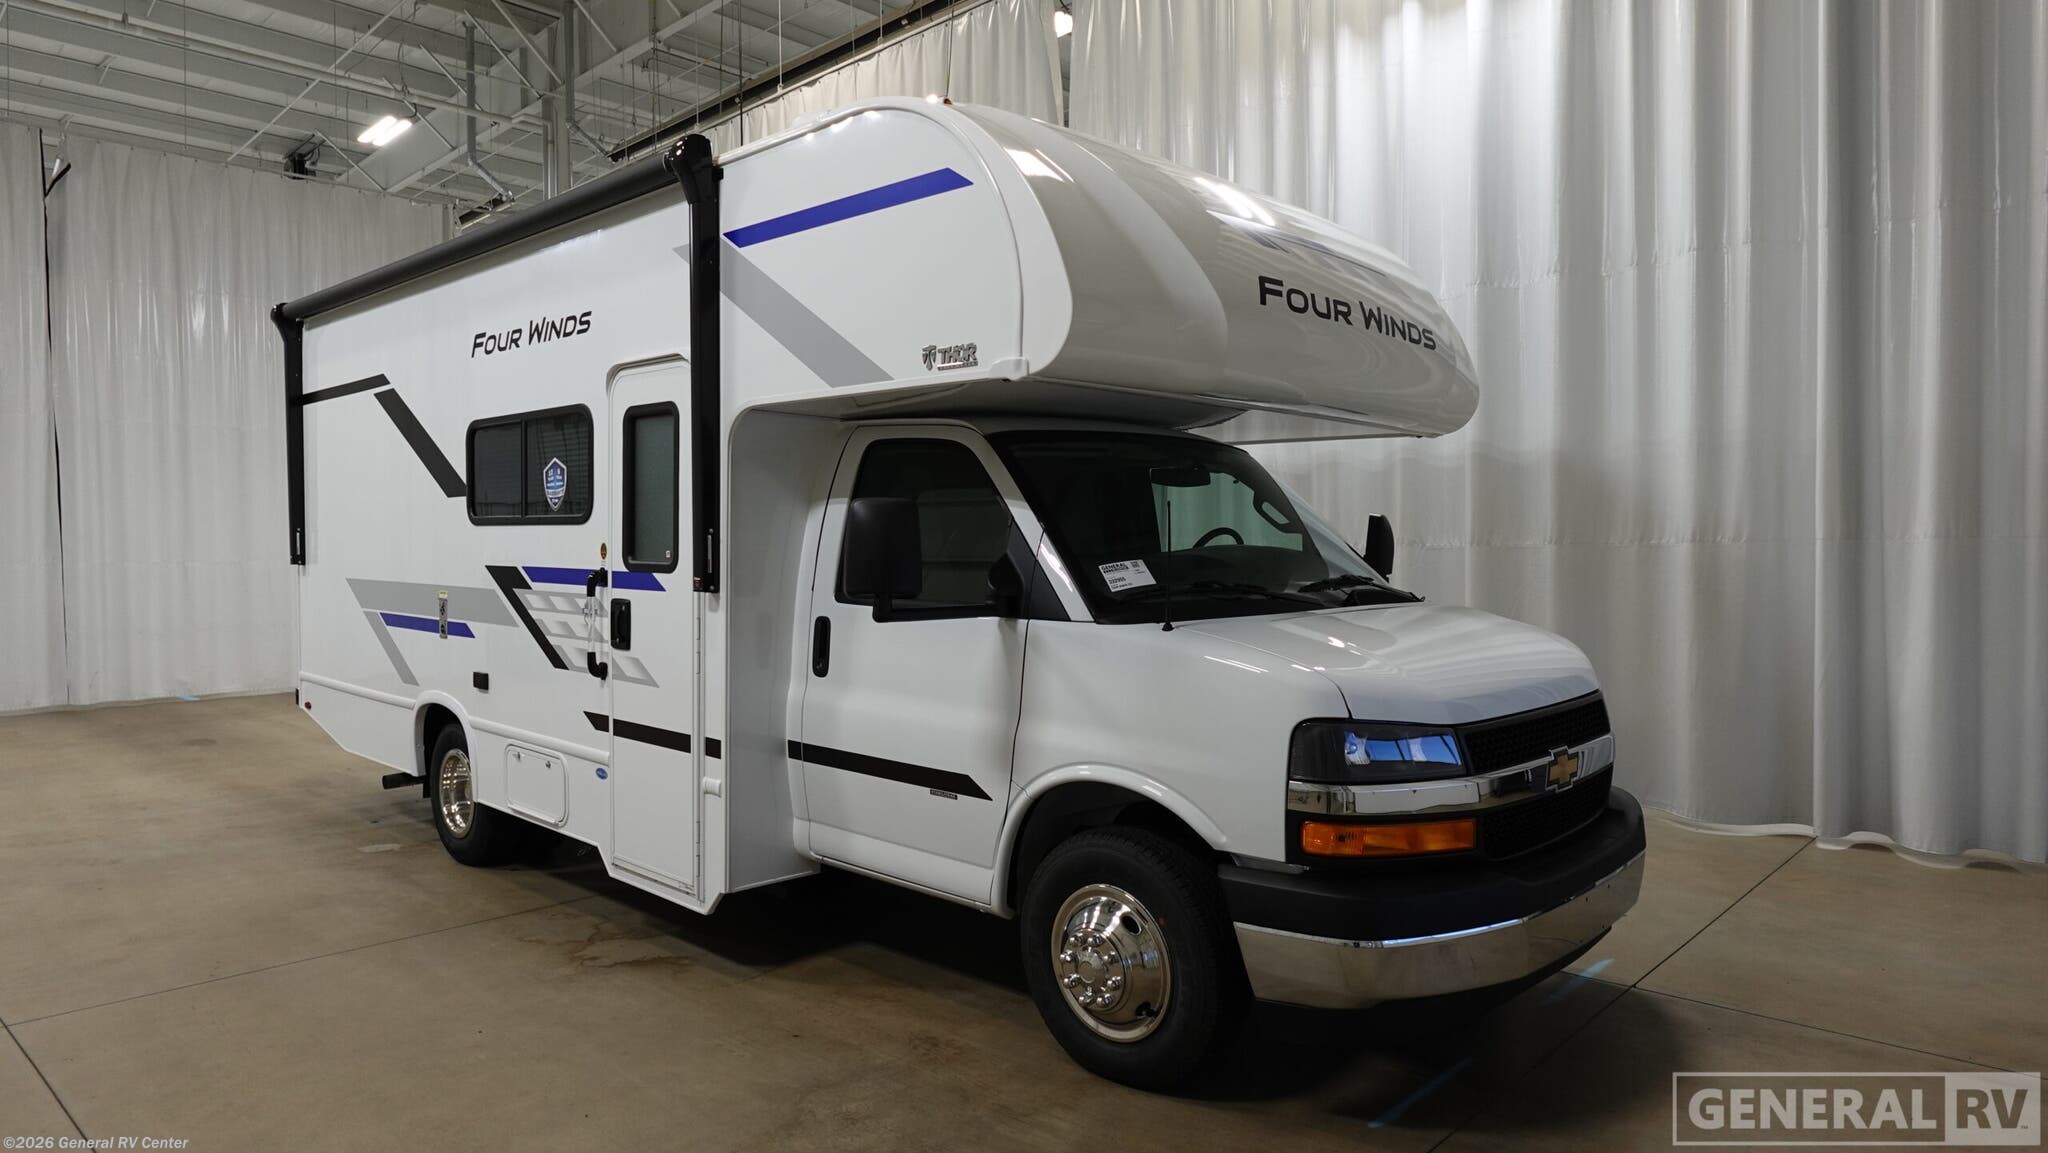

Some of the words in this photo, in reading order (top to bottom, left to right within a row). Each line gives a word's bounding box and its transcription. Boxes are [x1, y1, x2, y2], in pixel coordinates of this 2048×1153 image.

[471, 328, 523, 358] FOUR
[528, 310, 593, 346] WINDS
[1258, 275, 1353, 326] FOUR
[1358, 300, 1436, 351] WINDS
[937, 342, 978, 365] THOR
